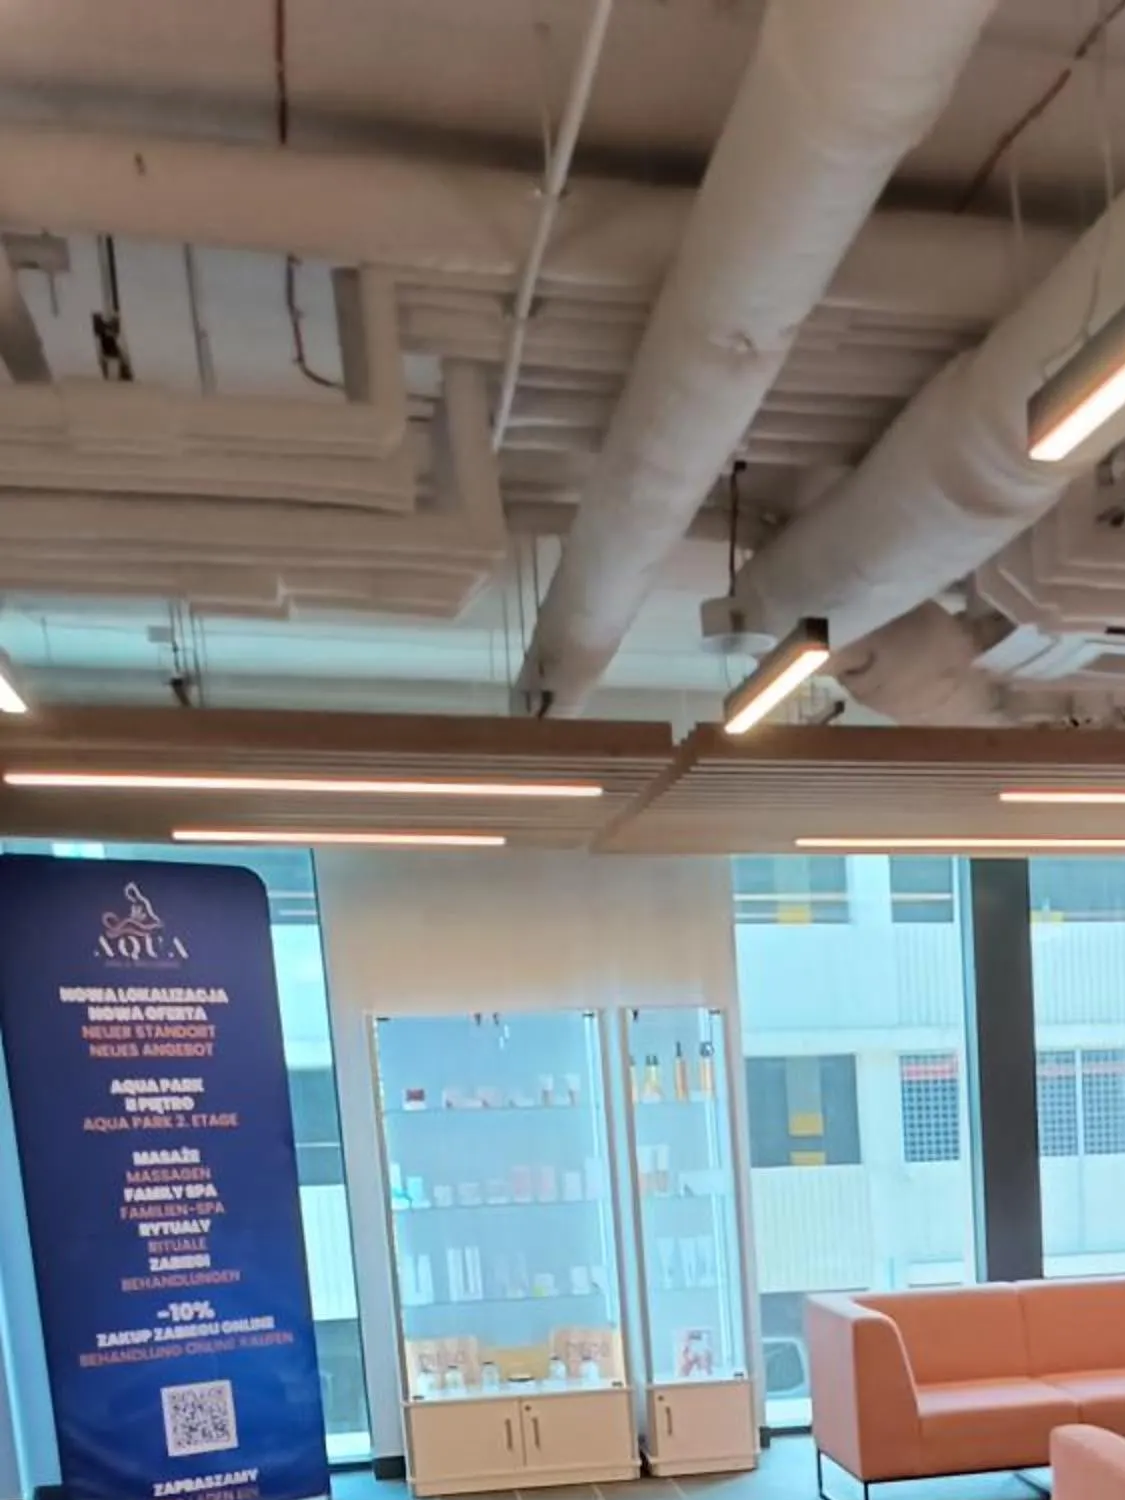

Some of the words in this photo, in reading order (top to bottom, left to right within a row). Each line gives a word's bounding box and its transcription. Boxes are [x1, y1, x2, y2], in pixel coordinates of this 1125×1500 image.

[94, 934, 189, 960] AQUA
[59, 986, 117, 1003] NOWA
[88, 1005, 144, 1021] NOWA
[145, 1006, 208, 1021] OFERTA
[81, 1024, 132, 1039] NEUER
[135, 1024, 216, 1039] STANDORT
[89, 1042, 140, 1057] NEUES
[142, 1042, 214, 1057] ANGEBOT
[110, 1079, 159, 1095] AQUA
[159, 1077, 204, 1093] PARK
[83, 1116, 129, 1132] AQUA
[131, 1114, 173, 1129] PARK
[191, 1112, 239, 1127] ETAGE
[125, 1167, 212, 1183] MASSAGEN
[123, 1184, 184, 1202] FAMILY
[185, 1183, 218, 1199] SPA
[119, 1201, 226, 1219] FAMILIEN-SPA
[147, 1236, 207, 1253] RITUALE
[120, 1269, 241, 1292] BEHANDLUNGEN
[156, 1300, 216, 1322] -10%
[95, 1329, 153, 1348] ZAKUP
[221, 1316, 275, 1335] ONLINE
[79, 1343, 183, 1367] BEHANDLUNG
[152, 1466, 259, 1497] ZAPRASZAMY
